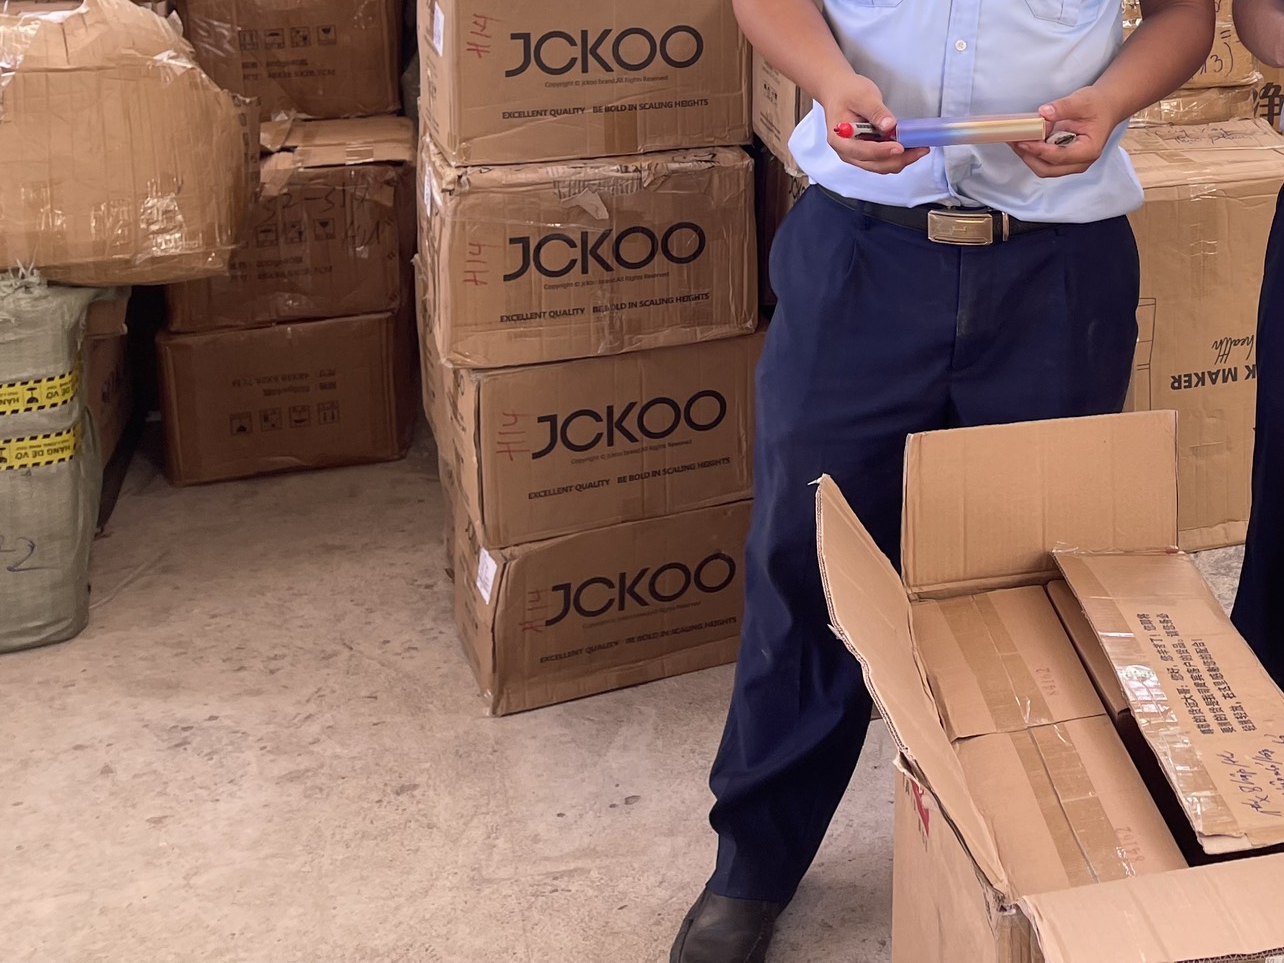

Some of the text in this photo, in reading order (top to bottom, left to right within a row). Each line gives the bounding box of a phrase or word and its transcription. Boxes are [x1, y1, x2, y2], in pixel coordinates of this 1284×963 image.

[505, 24, 704, 78] JCKOO
[502, 98, 709, 119] EXCELLENT QUALITY BE BOLD IN SCALING HEIGHTS
[503, 222, 706, 282] JCKOO
[500, 312, 547, 323] EXCELLENT
[549, 307, 585, 318] QUALITY
[628, 301, 638, 309] IN
[639, 297, 674, 307] SCALING
[675, 292, 710, 303] HEIGHTS
[1211, 334, 1255, 366] health
[1169, 366, 1238, 391] MAKER
[532, 389, 728, 460] JCKOO
[528, 484, 574, 500] EXCELLENT
[574, 478, 610, 492] QUALITY
[617, 476, 628, 484] BE
[629, 472, 650, 482] BOLD
[662, 463, 696, 475] SCALING
[697, 456, 731, 469] HEIGHTS
[545, 552, 737, 627] JCKOO
[540, 647, 584, 663] EXCELLENT
